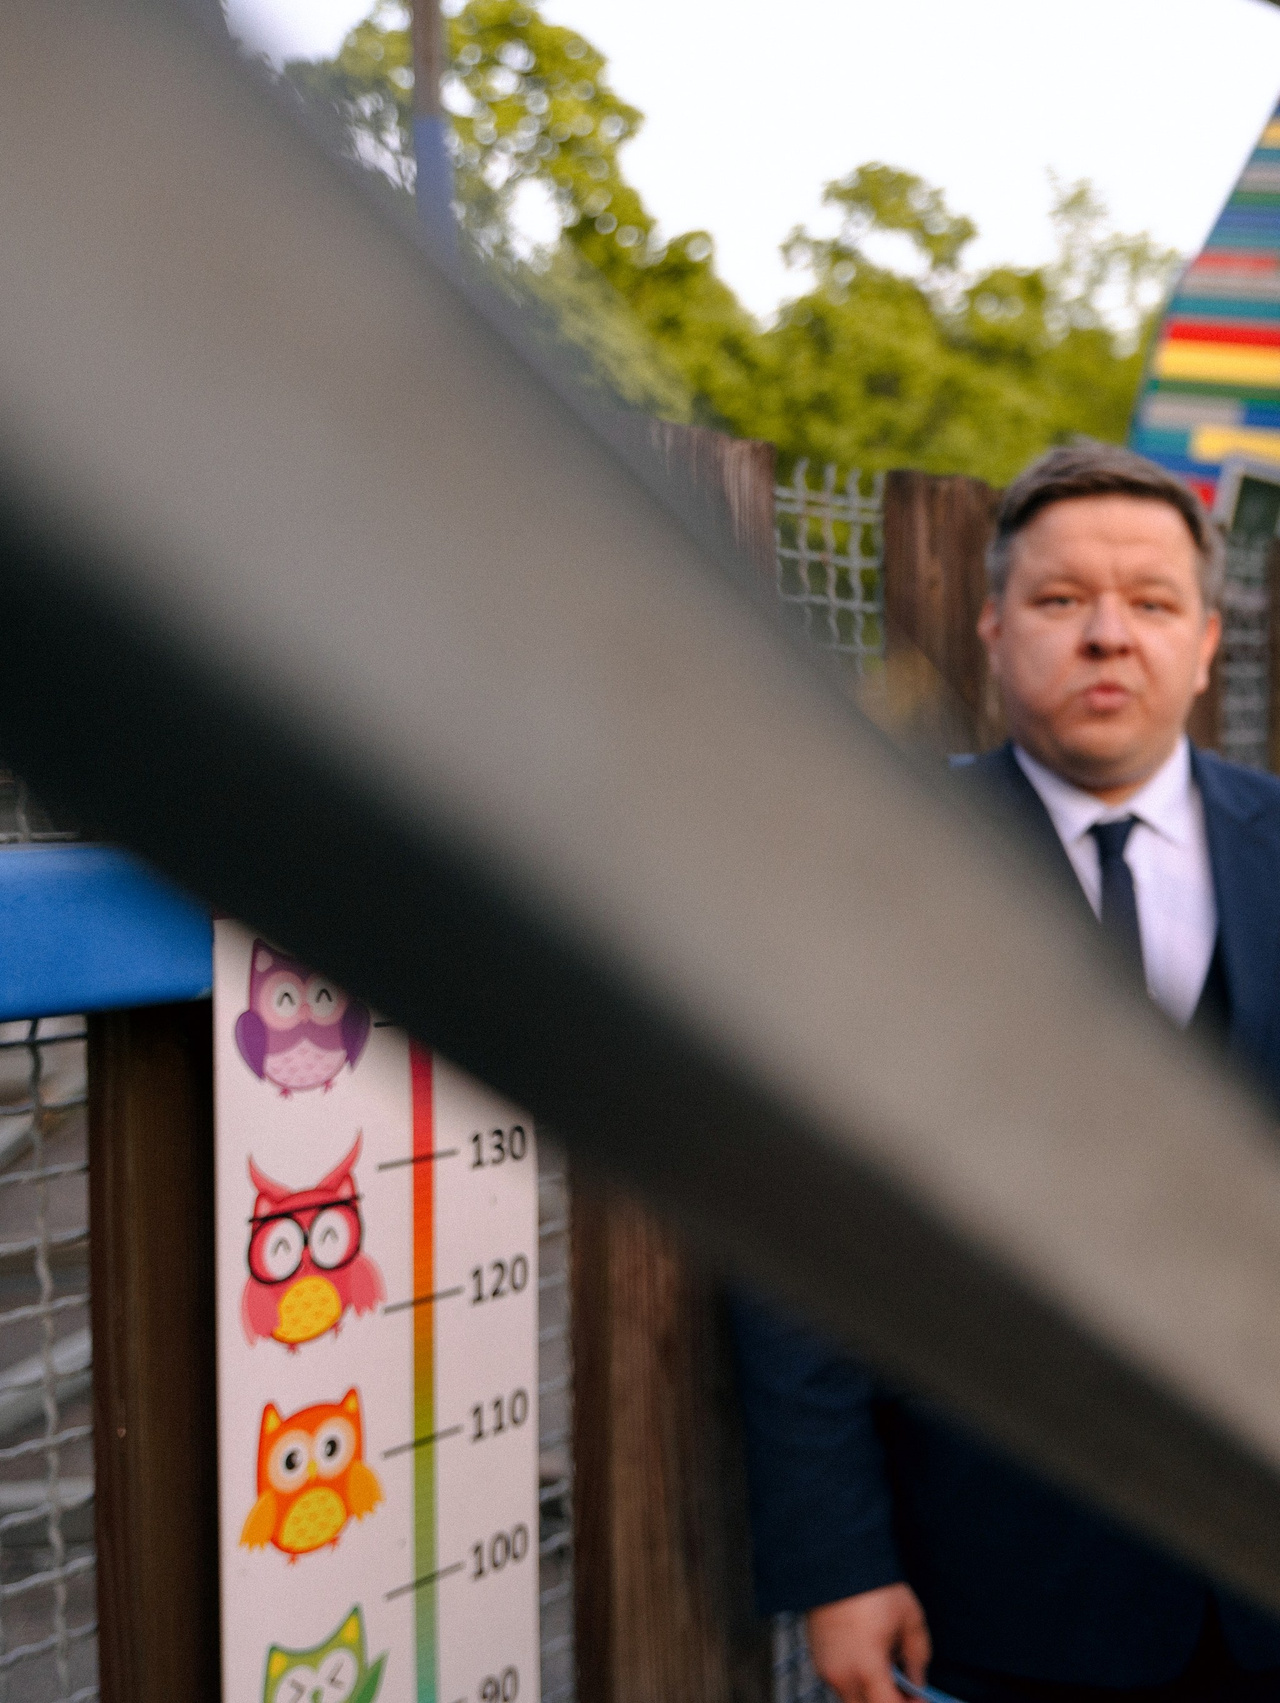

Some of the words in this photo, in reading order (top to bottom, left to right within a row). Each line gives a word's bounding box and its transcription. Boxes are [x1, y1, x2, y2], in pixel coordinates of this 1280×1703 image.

[471, 1125, 526, 1168] 130
[471, 1254, 528, 1305] 120
[471, 1387, 529, 1440] 110
[472, 1522, 529, 1579] 100
